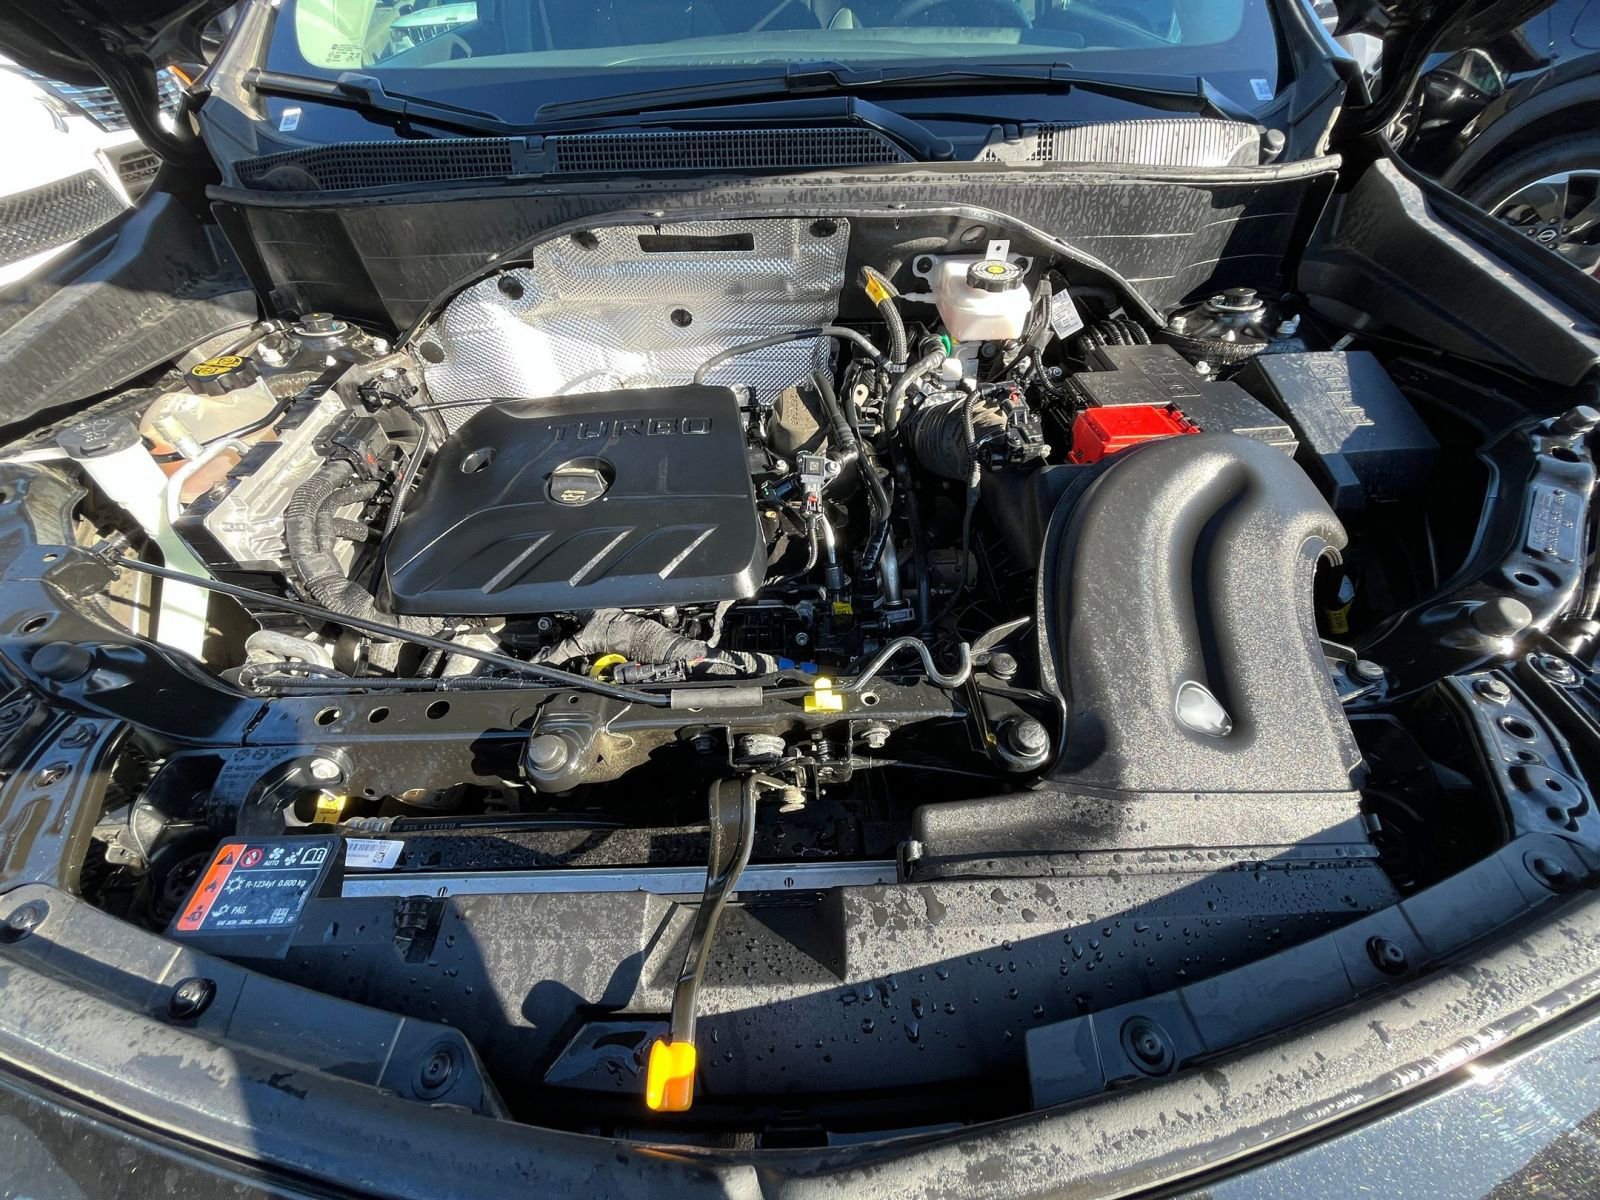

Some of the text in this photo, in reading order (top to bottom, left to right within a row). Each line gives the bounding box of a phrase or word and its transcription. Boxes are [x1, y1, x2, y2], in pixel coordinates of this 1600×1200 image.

[548, 417, 712, 441] TURBO
[422, 822, 456, 830] GALAXY
[263, 859, 280, 867] AUTO
[297, 879, 307, 888] kg
[230, 905, 247, 914] PAG
